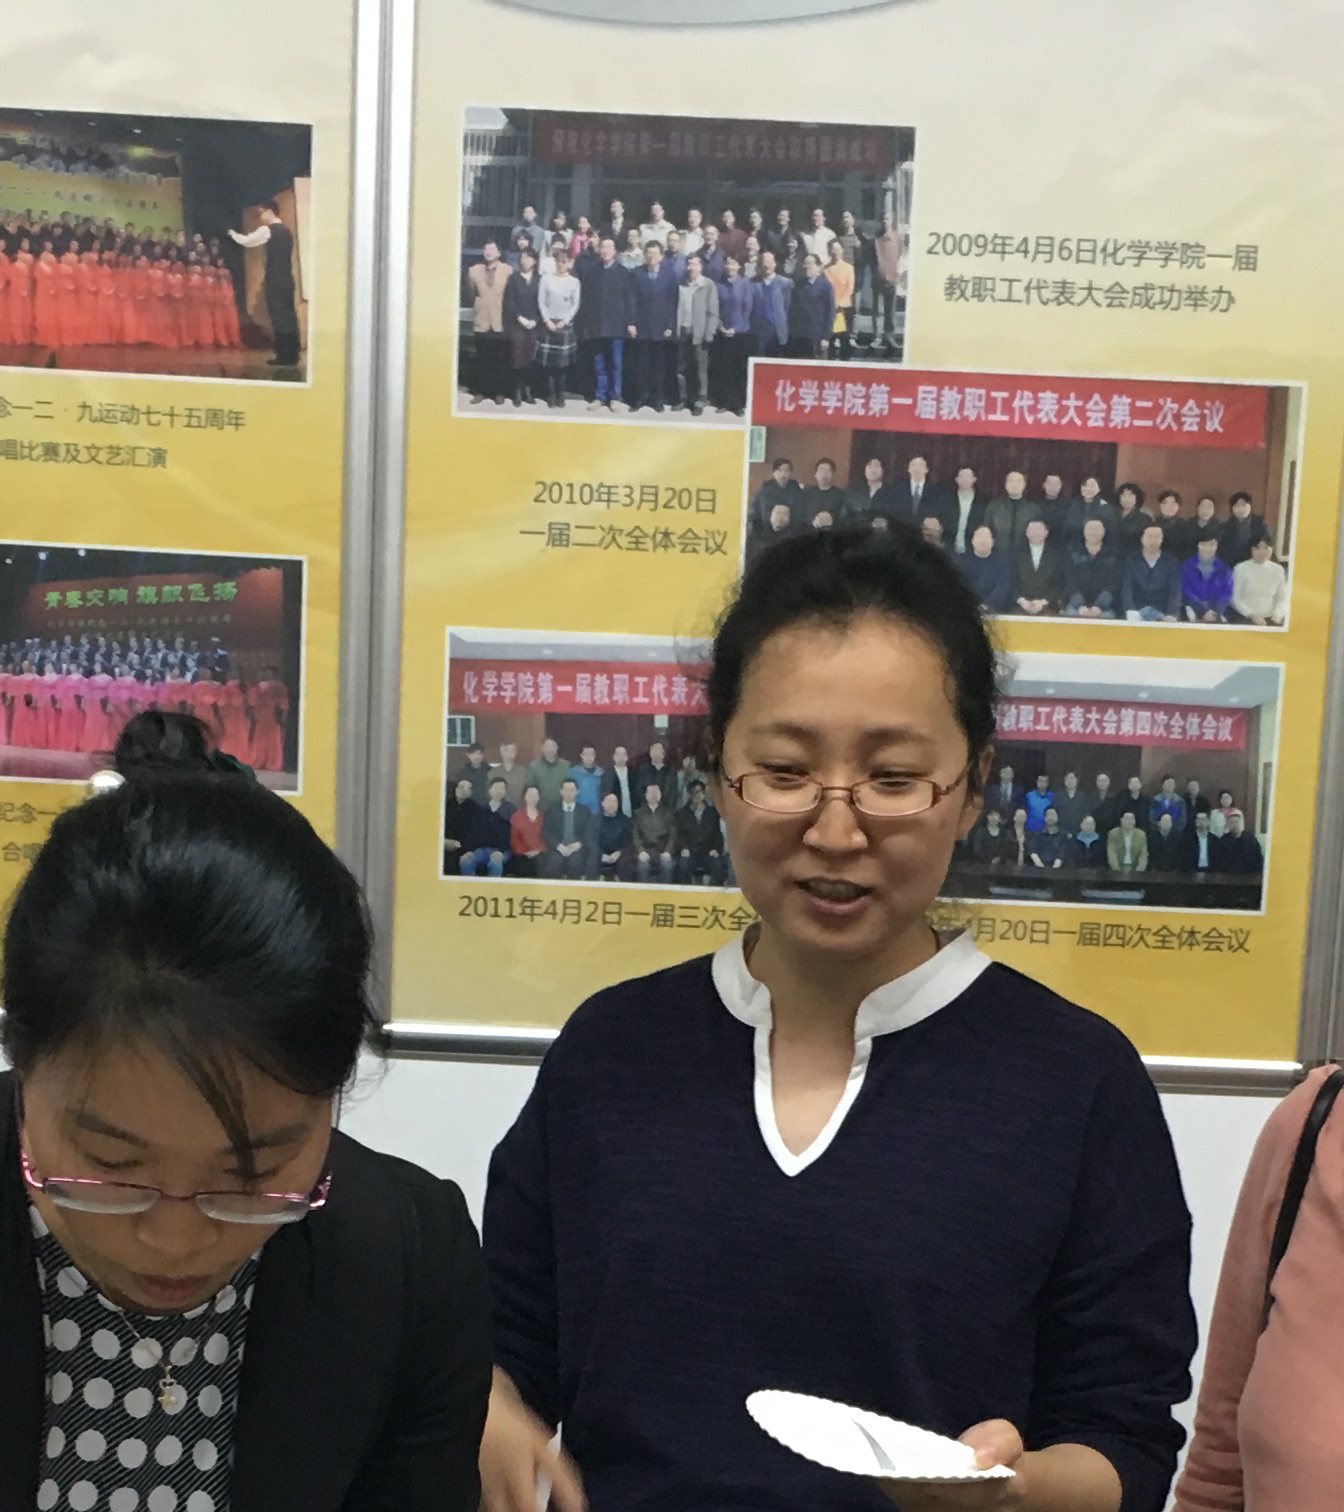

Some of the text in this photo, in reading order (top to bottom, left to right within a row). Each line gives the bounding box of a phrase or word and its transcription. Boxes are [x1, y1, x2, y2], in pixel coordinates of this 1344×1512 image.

[926, 231, 1259, 272] 2009年4月6日化学学院一届
[943, 274, 1237, 312] 教职工代表大会成功举办
[775, 379, 1226, 434] 化学学院第一届教职工代表大会第二次会议
[532, 480, 717, 515] 2010年3月20日
[519, 521, 729, 556] 一届二次全体会议
